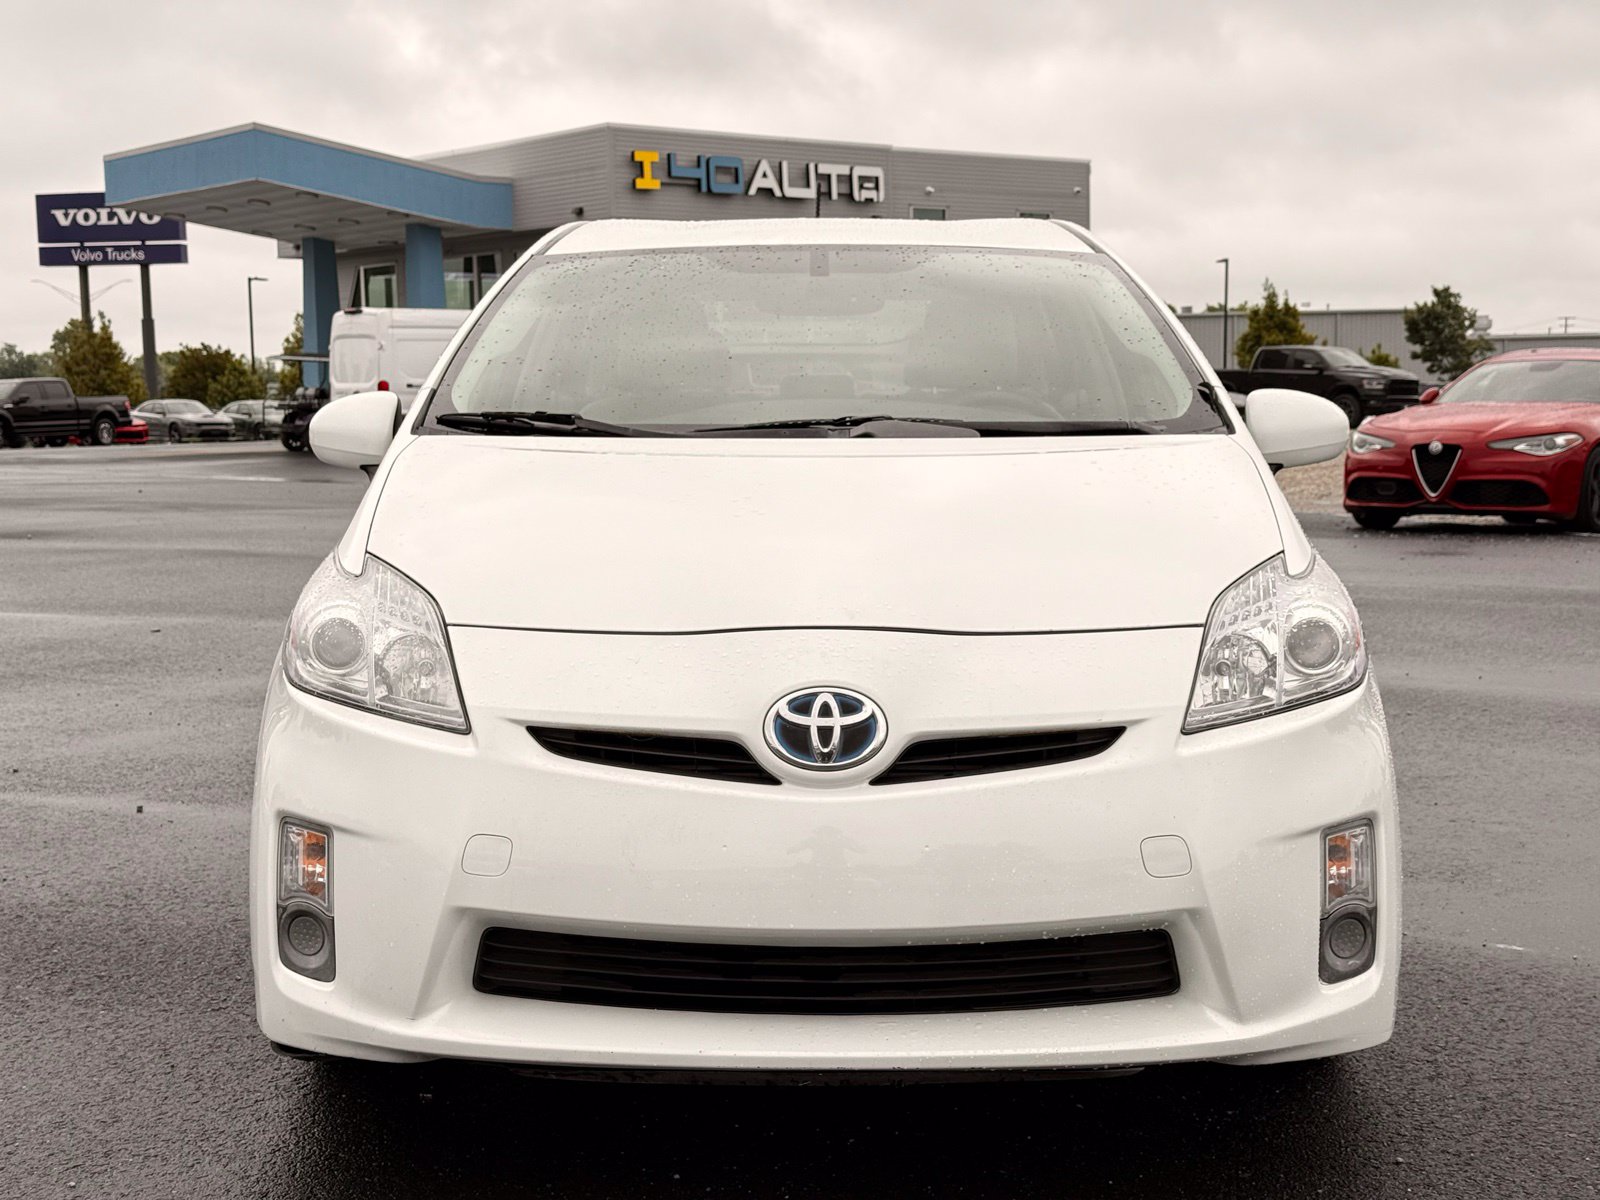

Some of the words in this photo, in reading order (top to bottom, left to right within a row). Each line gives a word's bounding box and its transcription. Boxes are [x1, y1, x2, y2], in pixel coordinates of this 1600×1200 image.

[51, 207, 162, 227] VOLVO
[71, 248, 103, 262] Volvo
[106, 247, 146, 262] Trucks
